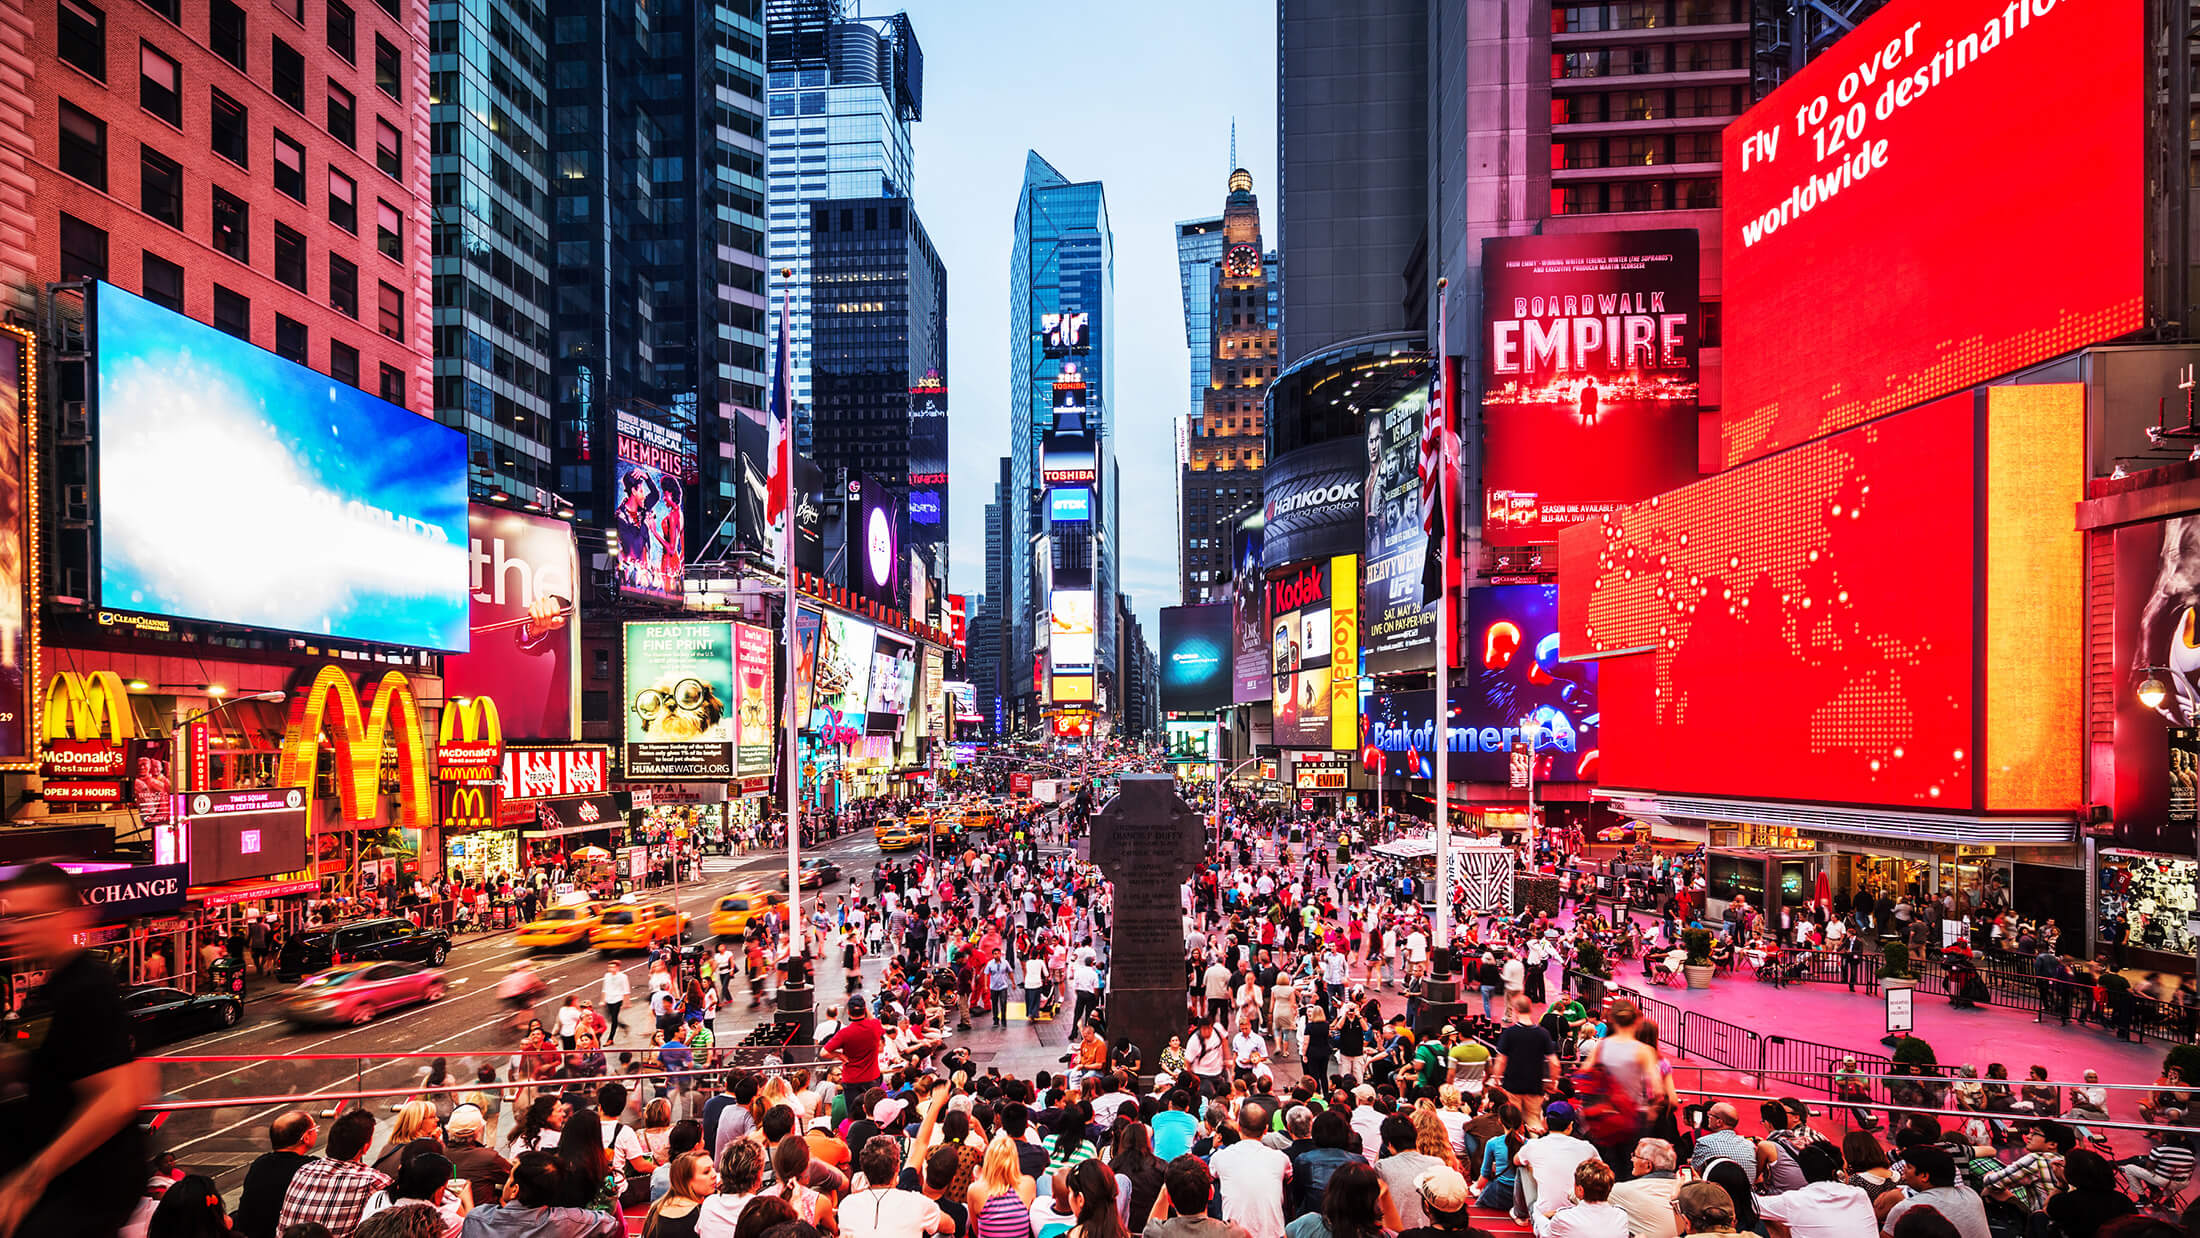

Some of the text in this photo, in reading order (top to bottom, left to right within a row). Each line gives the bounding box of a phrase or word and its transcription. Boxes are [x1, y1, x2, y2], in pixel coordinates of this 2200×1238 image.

[1813, 0, 2066, 163] 120 destinatio
[1742, 21, 1921, 172] Fly to over
[1742, 138, 1889, 248] worldwide
[1514, 292, 1665, 318] BOARDWALK
[1493, 313, 1688, 375] EMPIRE
[617, 420, 682, 453] BEST MUSICAL
[617, 435, 682, 476] MEMPHIS
[1044, 471, 1095, 481] TOSHIBA
[1284, 501, 1359, 521] driving emotion
[1541, 505, 1566, 513] SEASON
[1567, 504, 1579, 512] ONE
[1580, 503, 1615, 512] AVAILABLE
[1571, 513, 1585, 522] DVD
[1275, 565, 1324, 614] Kodak
[1388, 571, 1416, 600] UFC
[1384, 601, 1420, 620] SAT. MAY 26
[646, 626, 711, 638] READ THE
[1371, 622, 1383, 637] LIVE
[1383, 620, 1394, 634] ON
[1394, 610, 1437, 631] PAY-PER-VIEW
[642, 639, 714, 651] FINE PRINT
[1333, 607, 1354, 701] Kodak
[1374, 715, 1577, 752] Bank of merica
[42, 751, 123, 764] McDonald's
[439, 748, 497, 758] McDonald's
[529, 771, 552, 782] FRIDAYS
[574, 769, 594, 779] FRIDAYS
[632, 764, 730, 773] HUMANEWATCH.ORG
[1317, 774, 1345, 787] EVITA
[44, 788, 117, 797] OPEN 24 HOURS
[229, 794, 269, 803] TIMES SQUARE
[235, 803, 256, 811] CENTER
[261, 800, 285, 809] MUSEUM
[78, 878, 179, 905] XCHANGE
